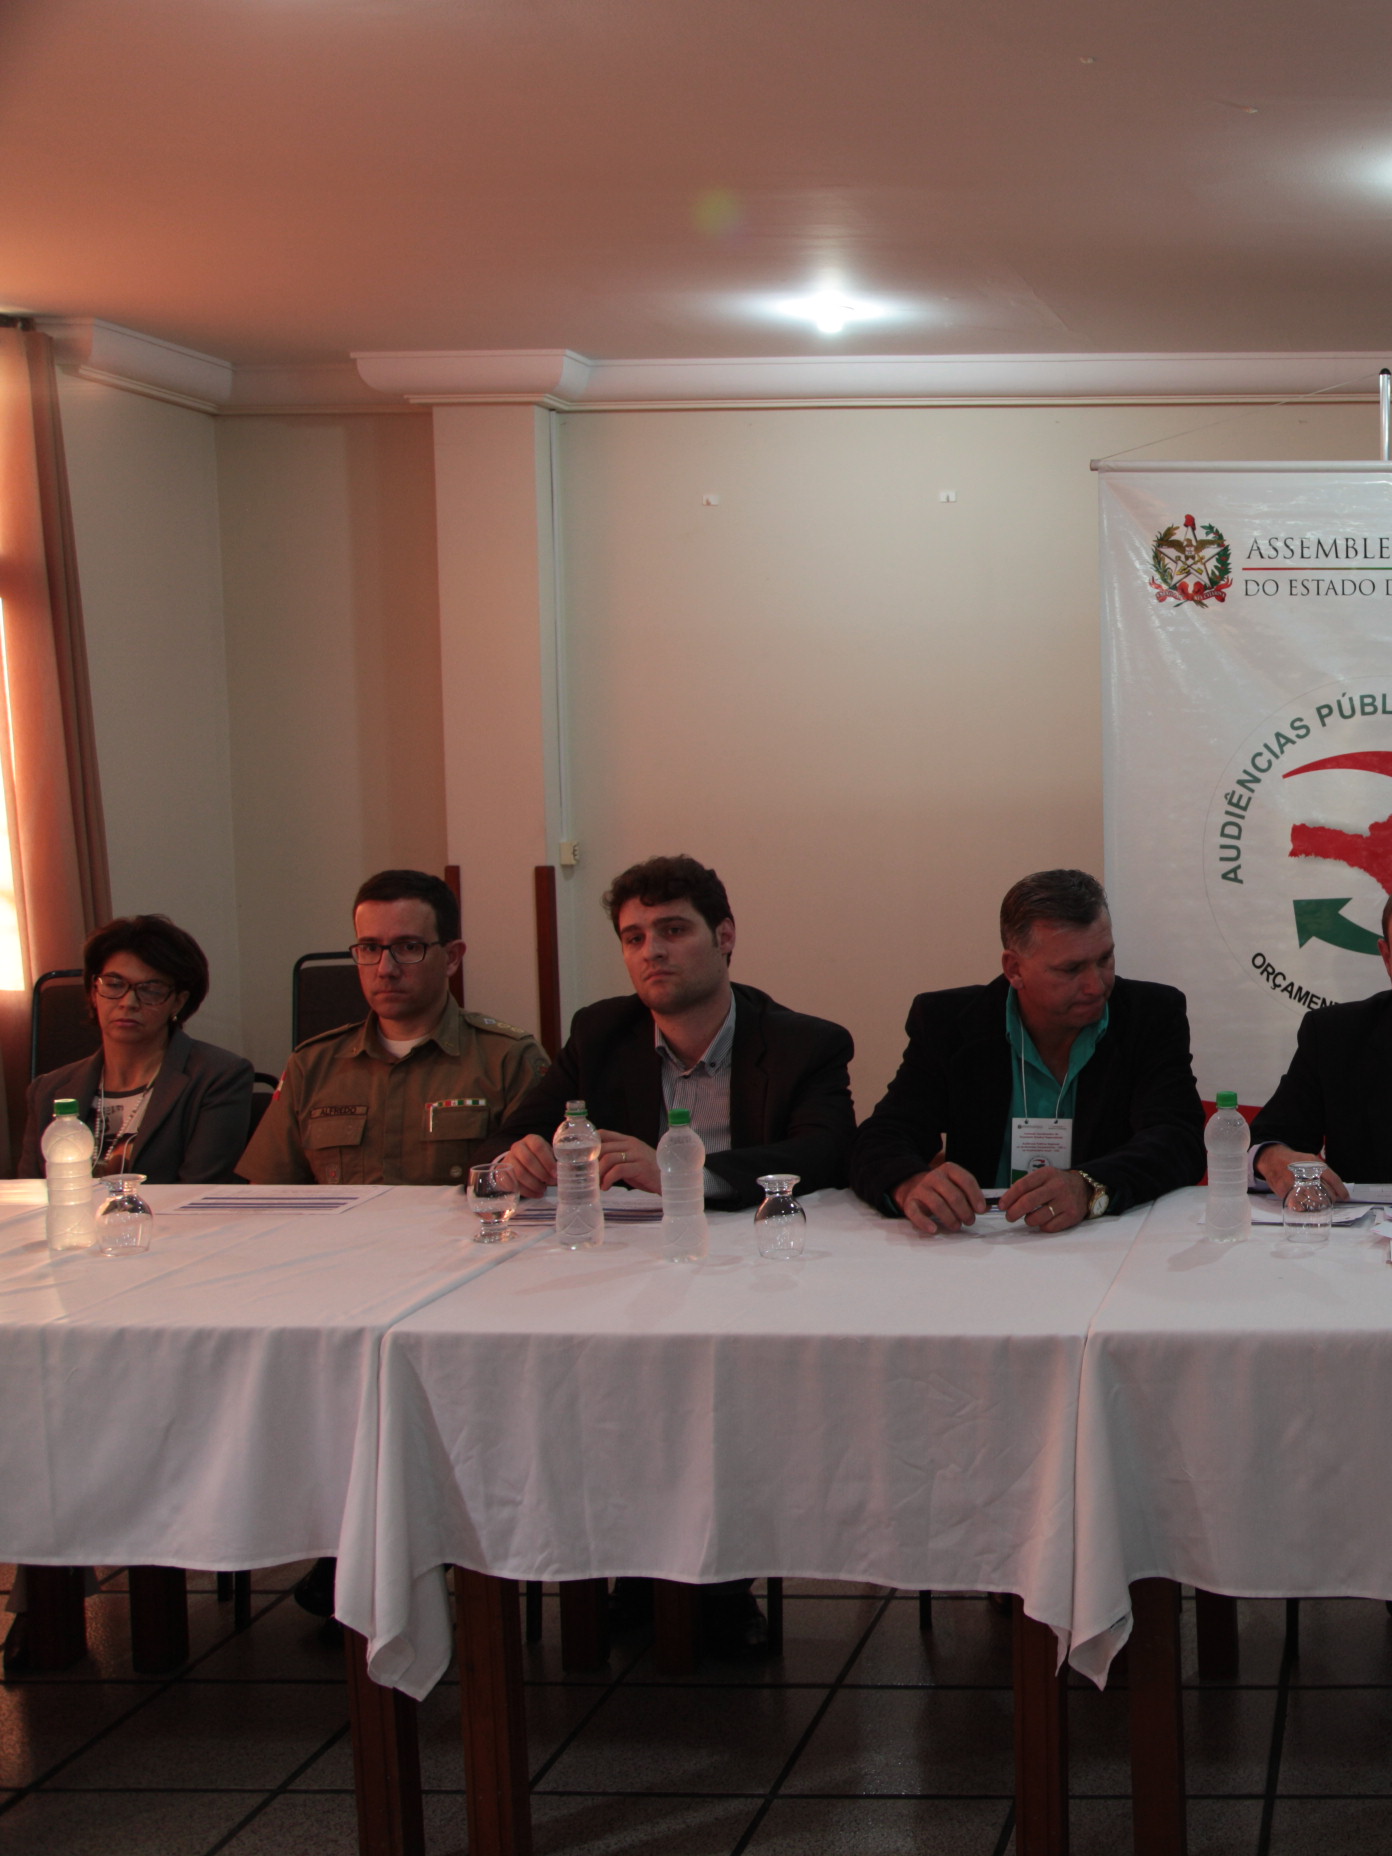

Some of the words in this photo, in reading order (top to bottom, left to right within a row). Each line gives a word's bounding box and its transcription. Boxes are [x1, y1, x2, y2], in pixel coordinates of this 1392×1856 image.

[1244, 578, 1280, 597] DO
[1289, 578, 1376, 597] ESTADO
[1219, 717, 1311, 885] AUDIÊNCIAS
[1251, 952, 1341, 1011] ORÇAMEN
